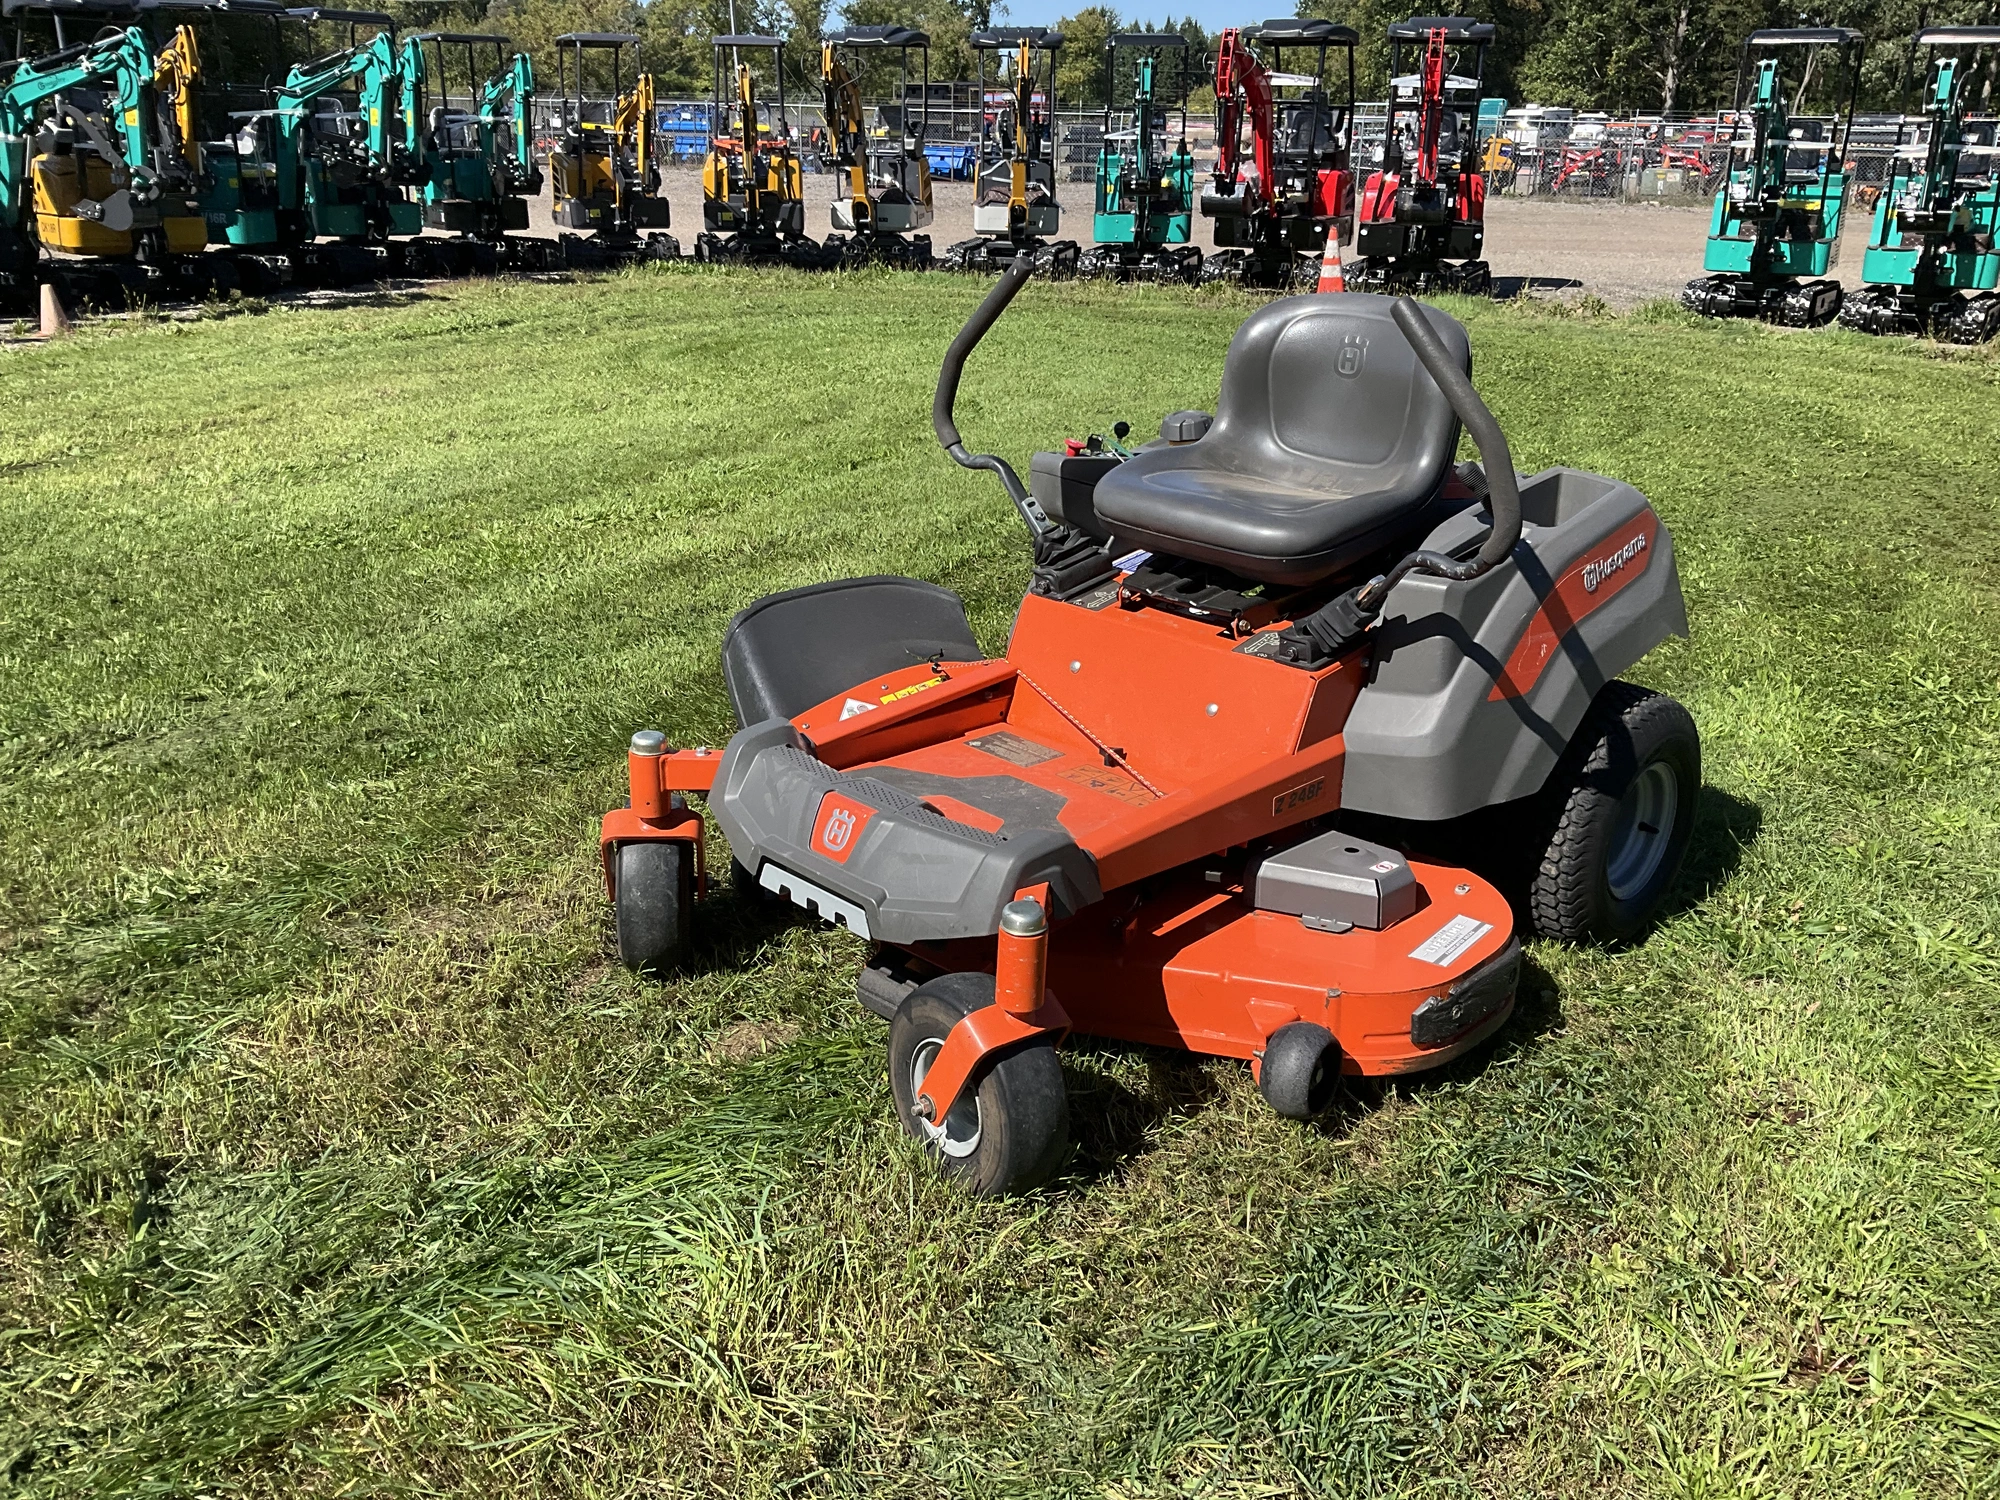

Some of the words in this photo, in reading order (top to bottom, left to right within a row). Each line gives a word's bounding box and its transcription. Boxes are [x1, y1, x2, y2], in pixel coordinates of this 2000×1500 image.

[1596, 532, 1646, 582] Husqvarna
[1275, 797, 1285, 814] Z
[1288, 780, 1324, 809] 248F
[1426, 923, 1465, 953] LIFETIME
